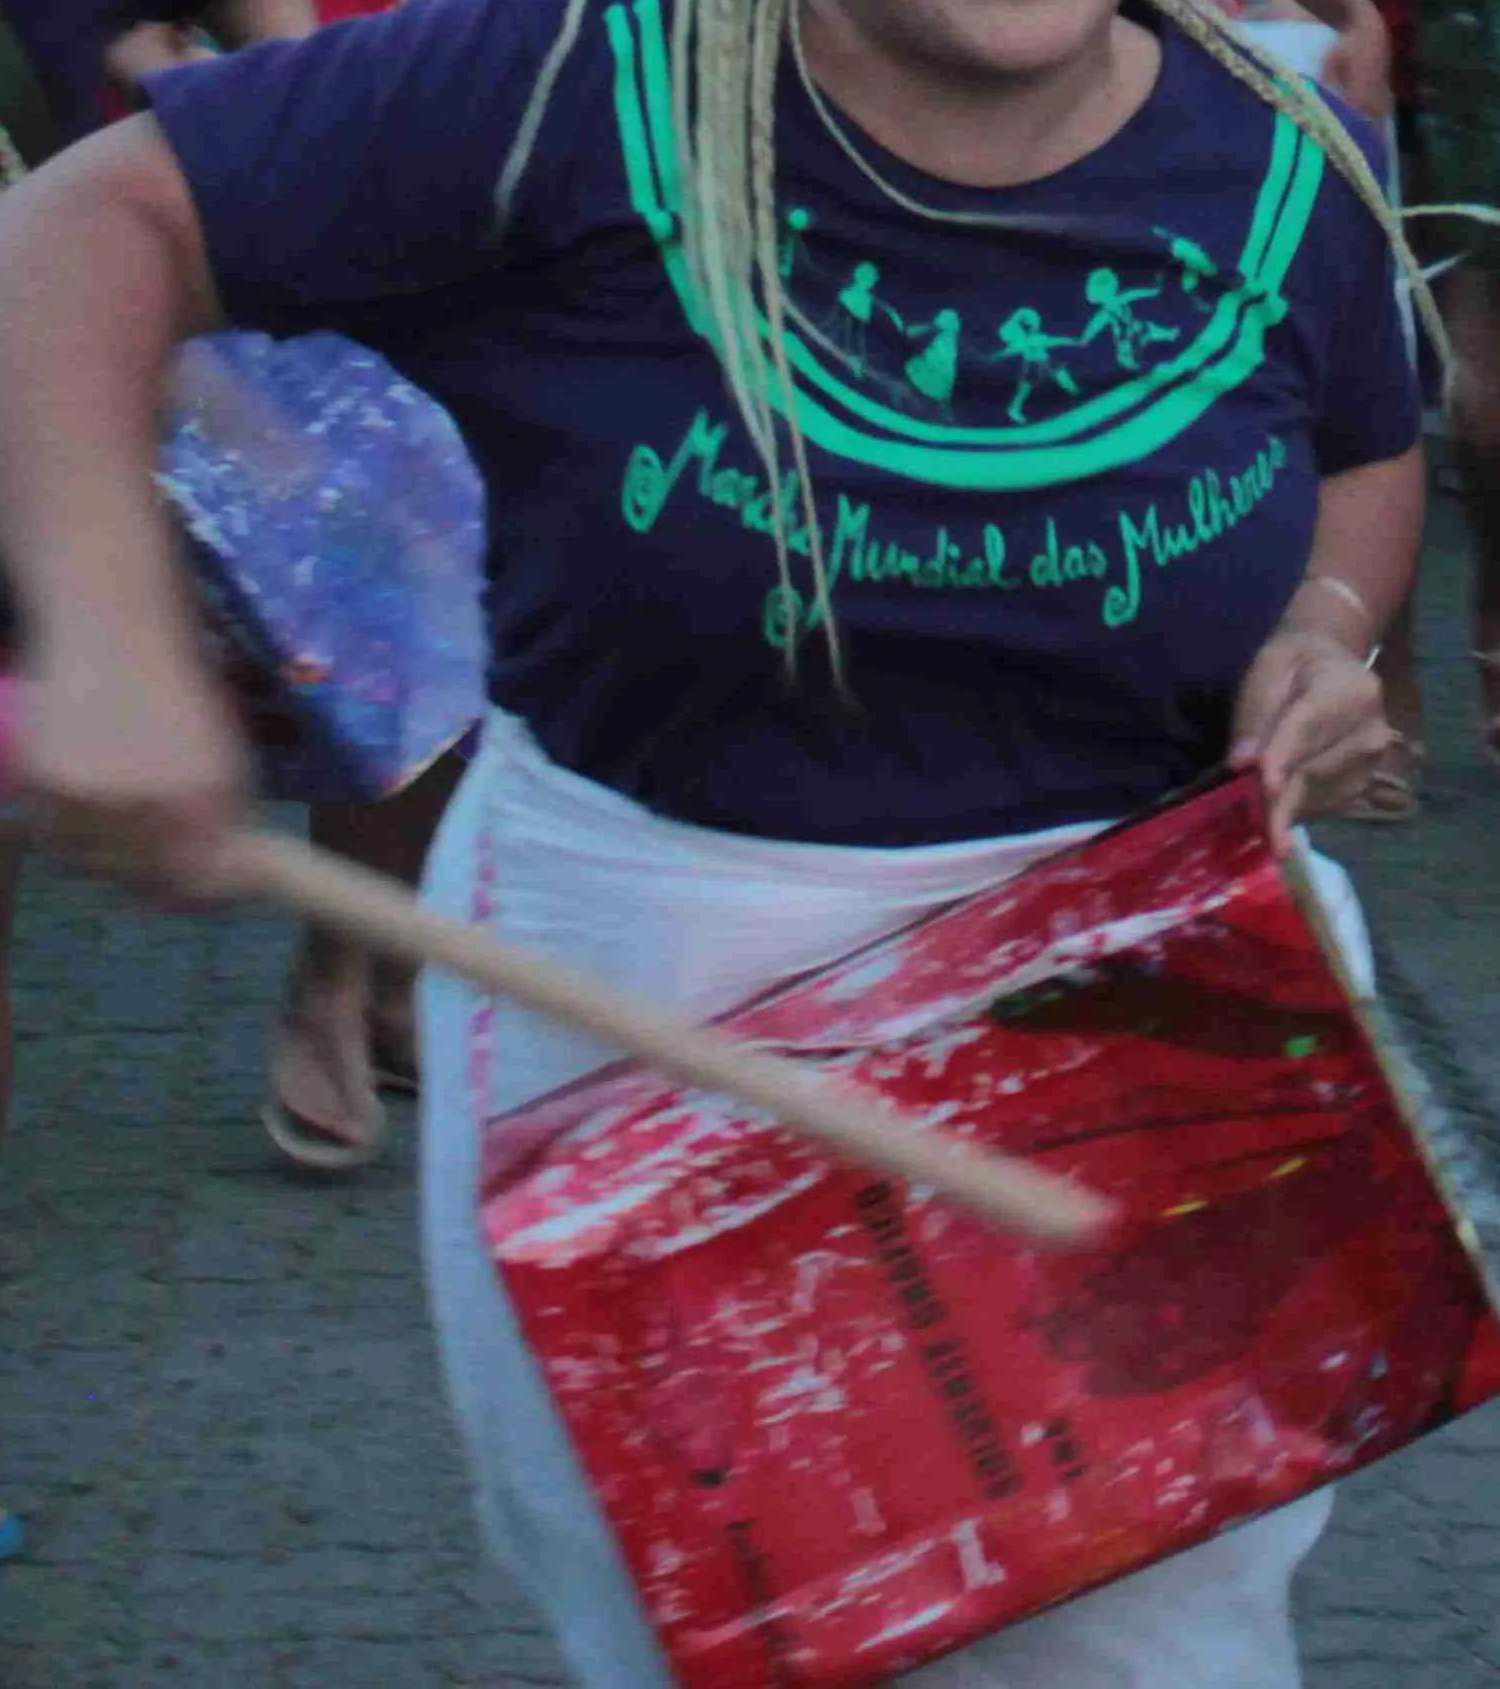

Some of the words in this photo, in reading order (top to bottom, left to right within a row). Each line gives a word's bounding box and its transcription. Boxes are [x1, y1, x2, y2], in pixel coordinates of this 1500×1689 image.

[760, 493, 1022, 647] Mundial
[1030, 515, 1107, 587] das
[1102, 434, 1288, 629] Mulheres
